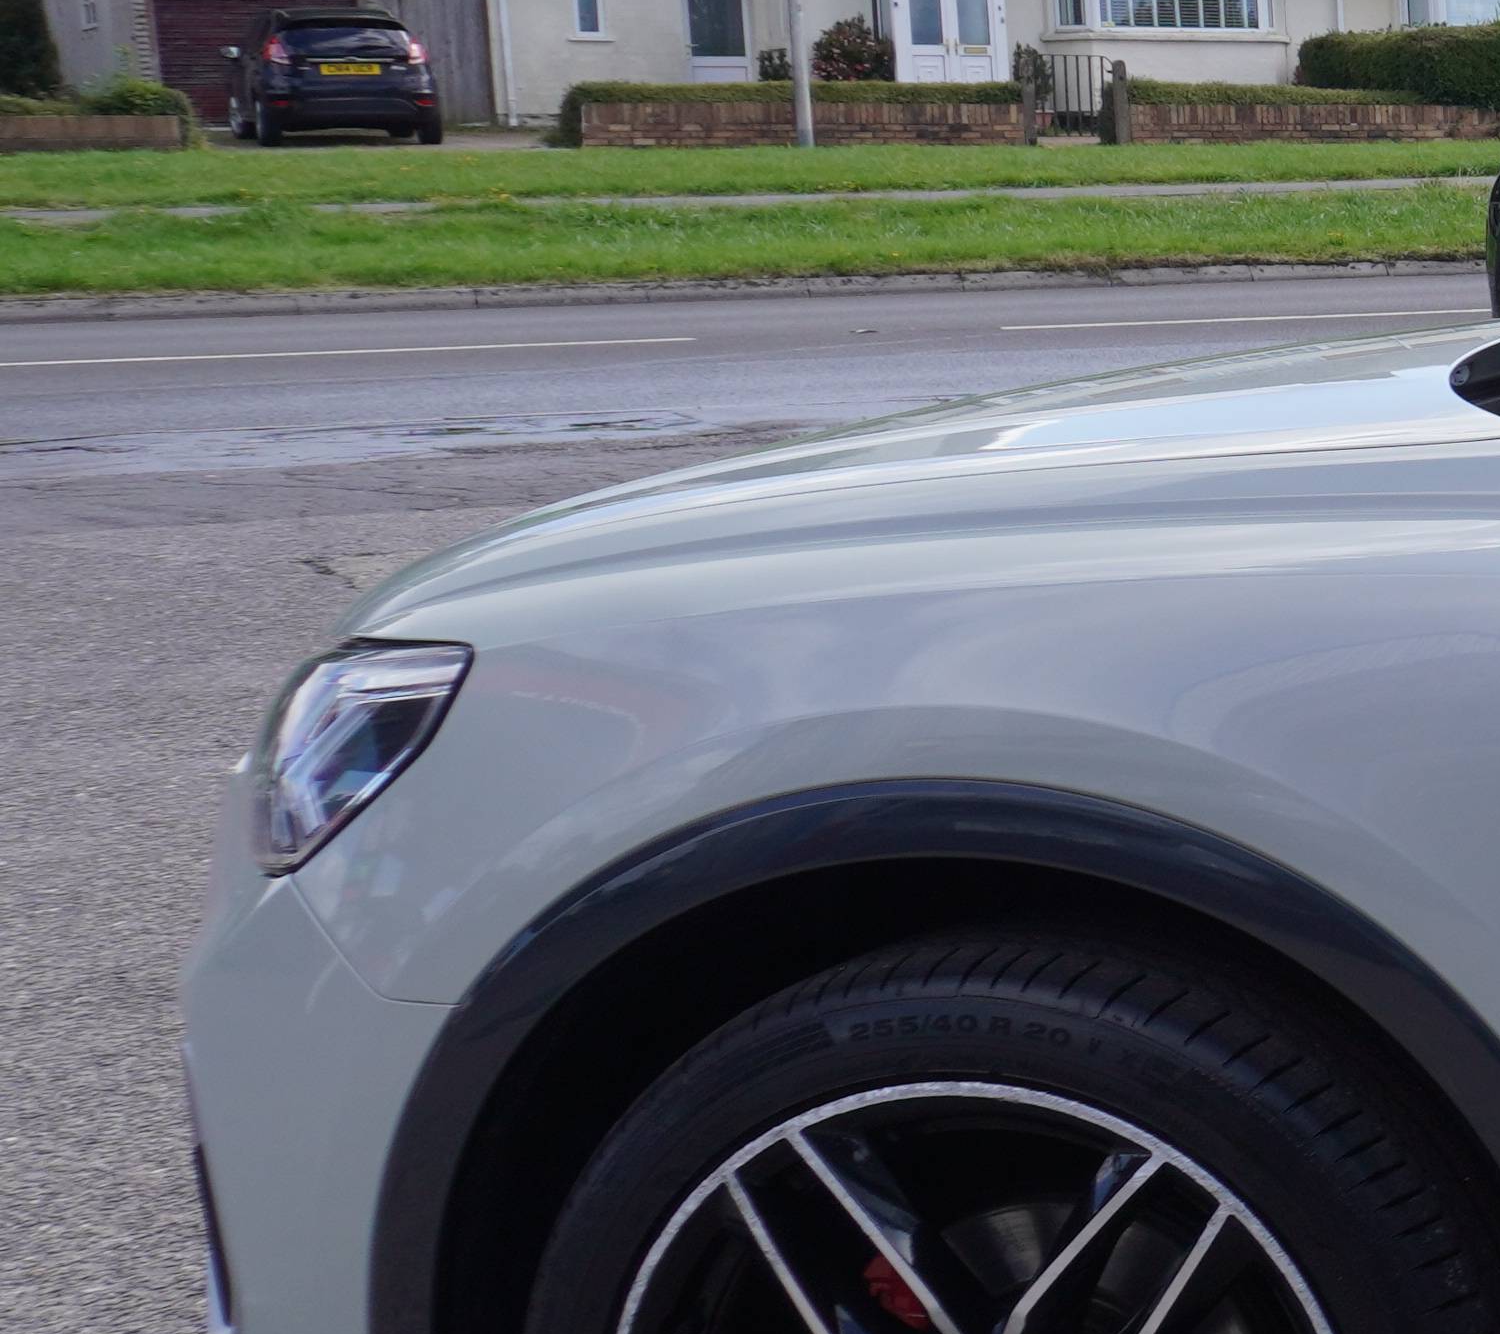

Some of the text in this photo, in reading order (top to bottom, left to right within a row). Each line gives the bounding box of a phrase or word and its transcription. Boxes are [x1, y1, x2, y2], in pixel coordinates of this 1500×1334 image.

[848, 1014, 978, 1041] 255/40
[987, 1015, 1011, 1037] R
[1021, 1021, 1070, 1048] 20
